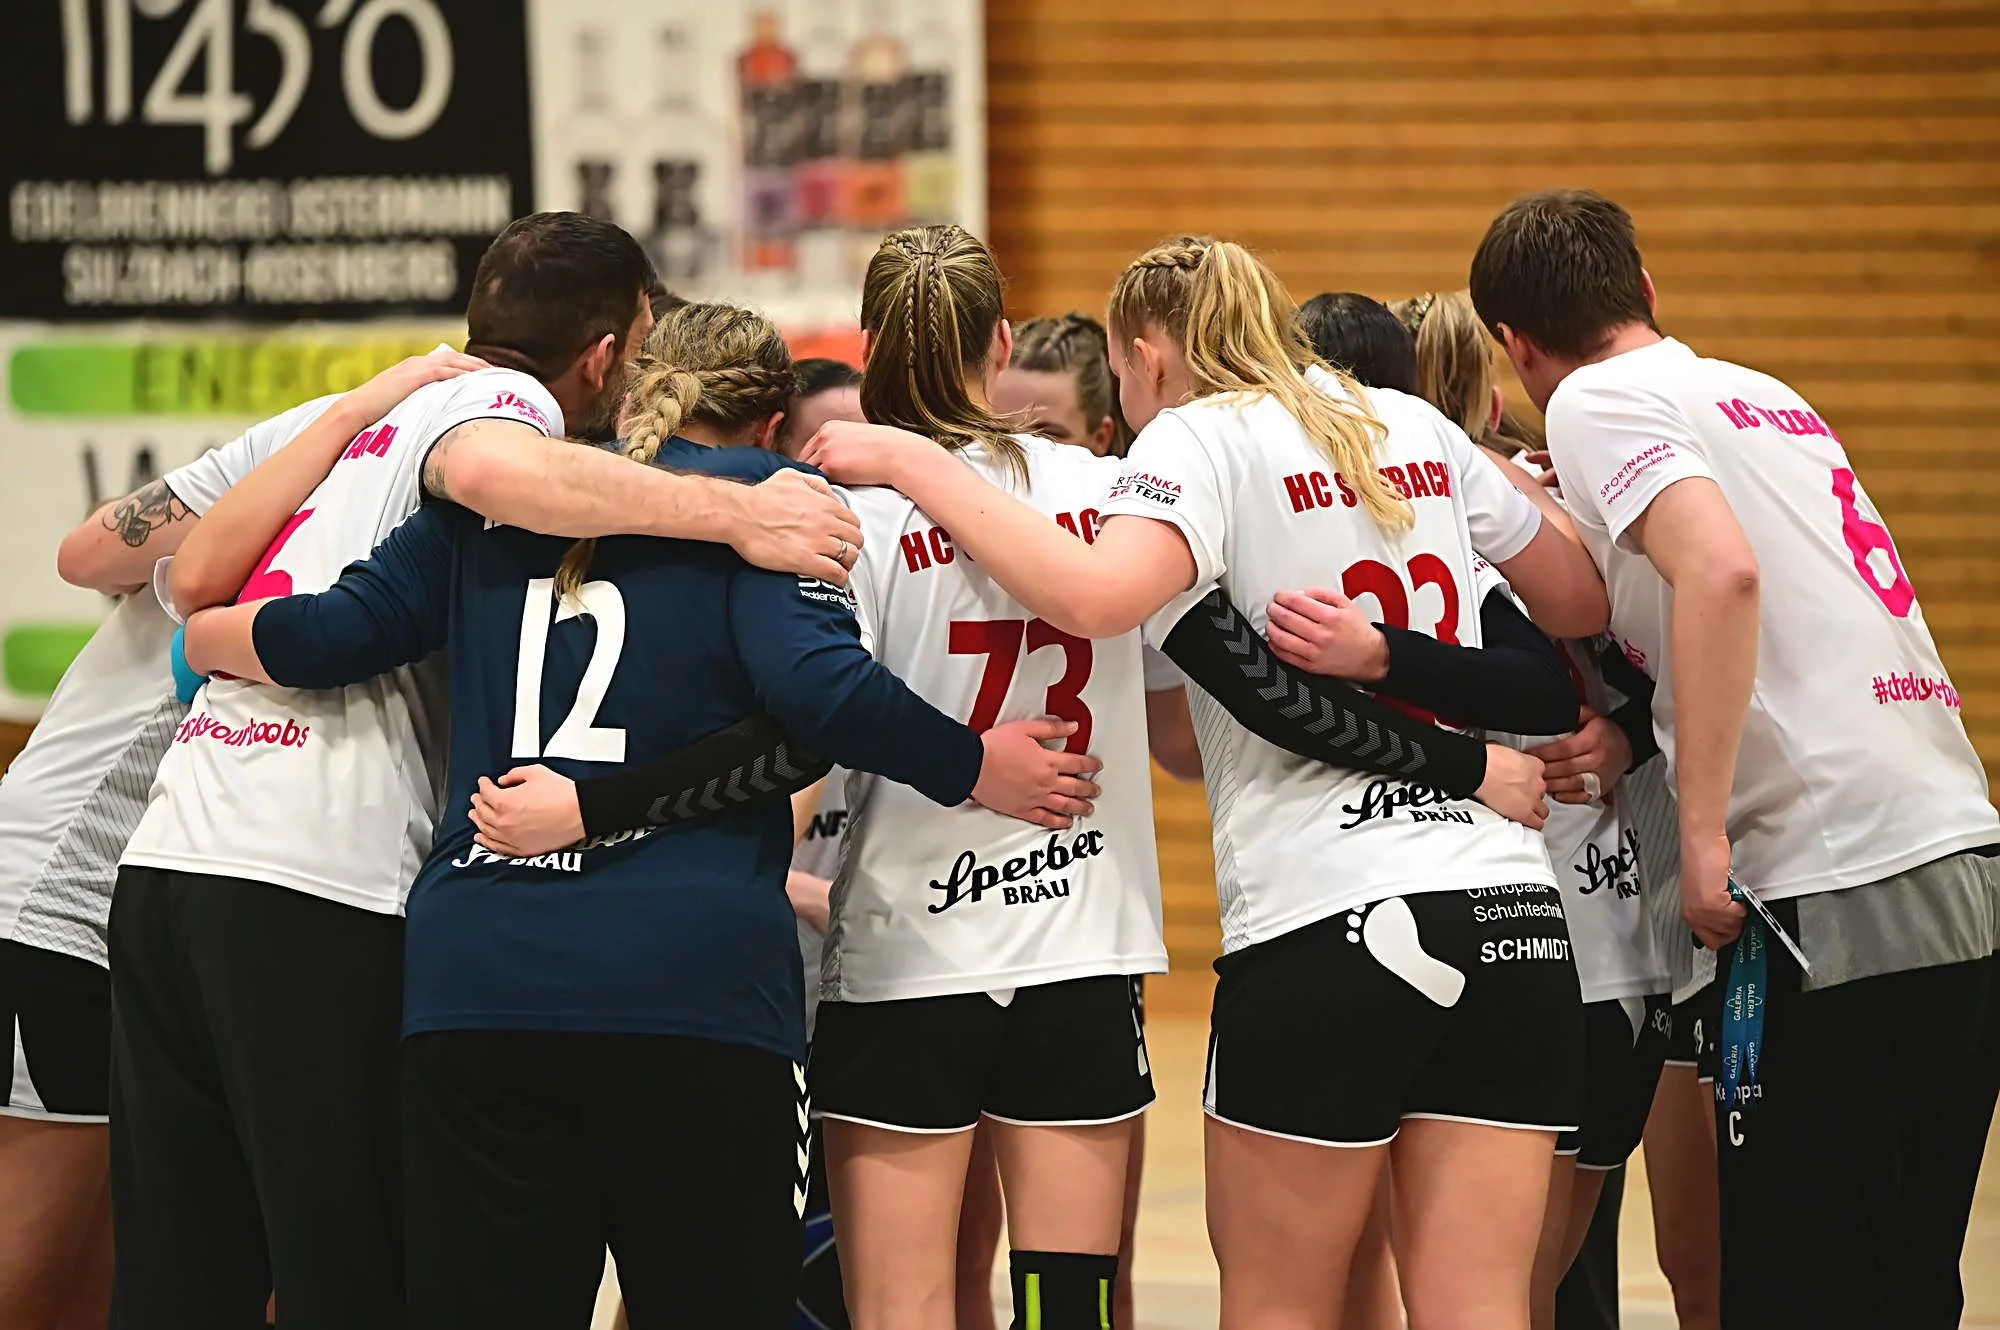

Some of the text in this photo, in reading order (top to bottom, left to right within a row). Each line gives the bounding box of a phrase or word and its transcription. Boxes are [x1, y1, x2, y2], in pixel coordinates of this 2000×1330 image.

[1283, 461, 1451, 513] HC SBACH
[1600, 443, 1671, 498] SPORTNANKA
[1135, 485, 1176, 505] TEAM
[900, 526, 954, 573] HC
[1831, 467, 1915, 618] 6
[511, 577, 627, 763] 12
[948, 617, 1094, 760] 73
[1408, 807, 1474, 825] BRÄU
[928, 829, 1104, 914] Sperber
[1003, 878, 1070, 905] BRÄU
[1480, 938, 1569, 963] SCHMIDT
[1734, 985, 1743, 1021] GALERIA
[1730, 1044, 1738, 1080] GALERIA
[1729, 1111, 1745, 1147] C
